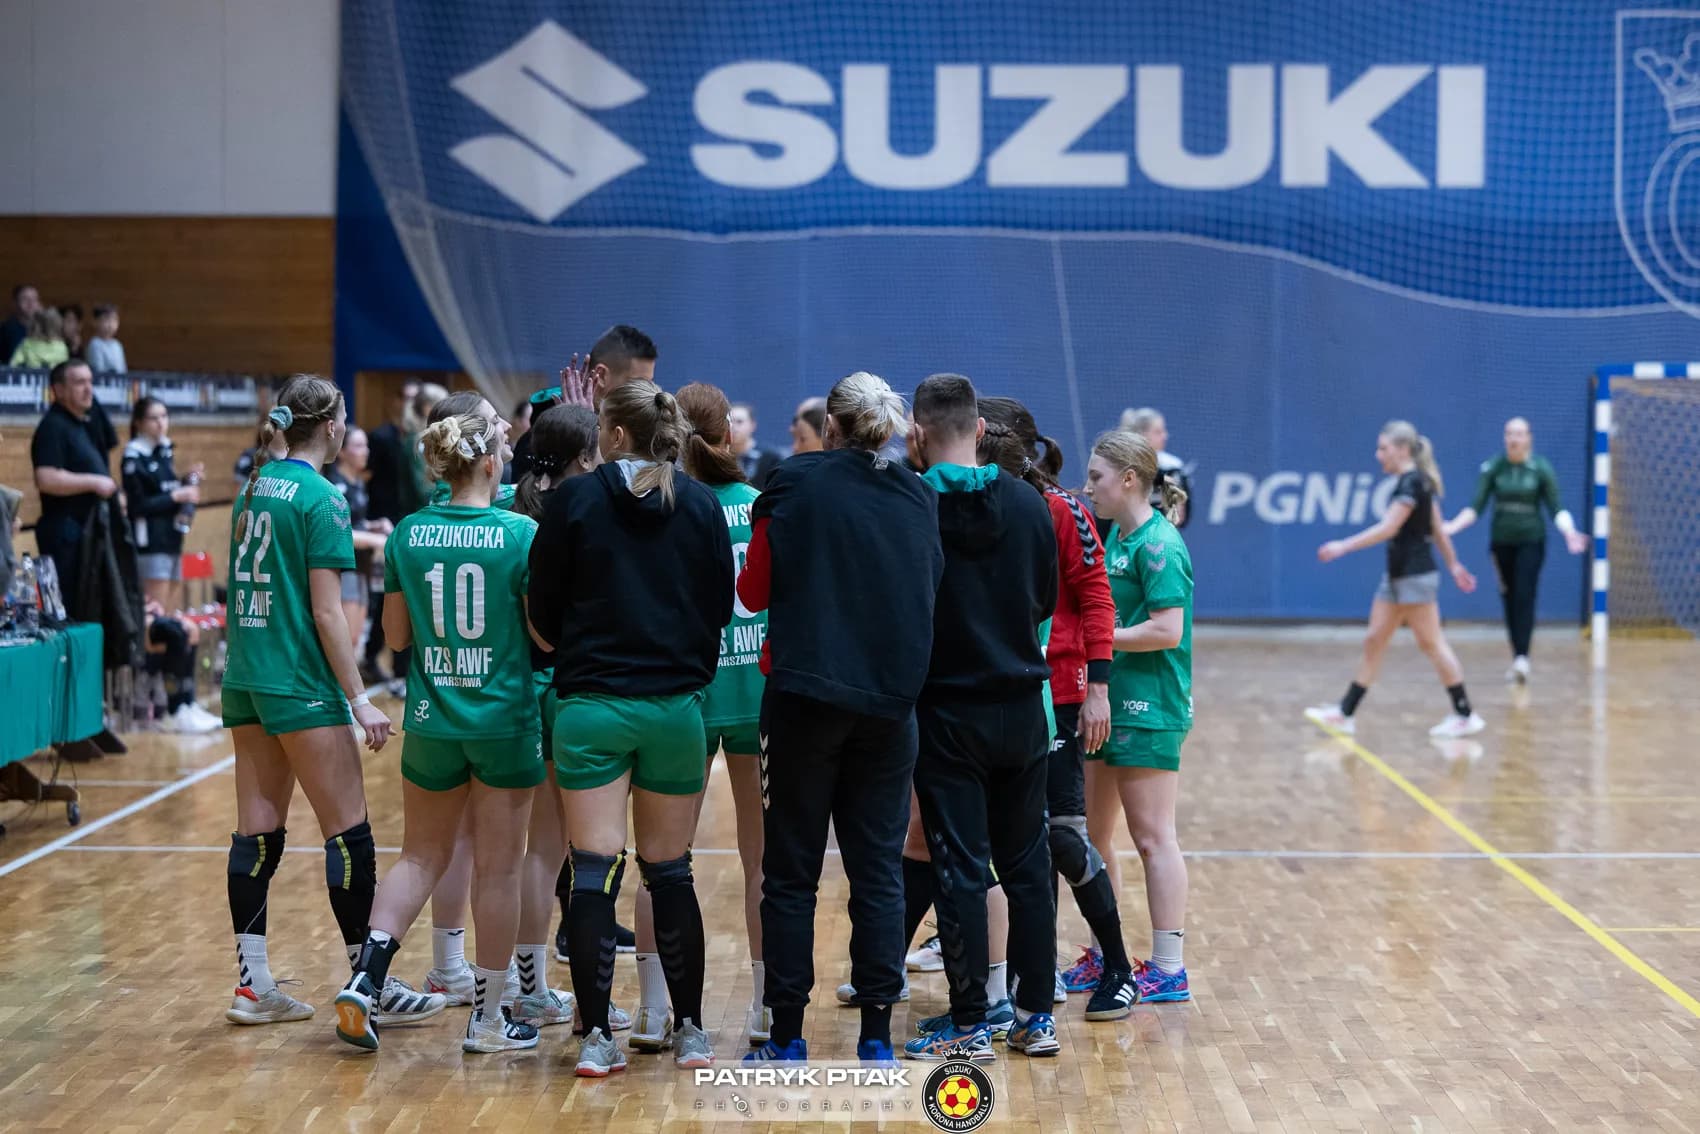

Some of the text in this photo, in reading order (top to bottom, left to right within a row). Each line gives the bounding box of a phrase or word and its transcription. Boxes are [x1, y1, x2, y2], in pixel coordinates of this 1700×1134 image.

[690, 61, 1486, 190] SUZUKI
[241, 477, 299, 502] ERNICKA
[235, 510, 271, 583] 22
[408, 525, 505, 549] SZCZUKOCKA
[235, 589, 273, 616] S AWF
[424, 563, 485, 640] 10
[424, 646, 493, 675] AZS AWF
[717, 653, 759, 667] ARSZAWA
[1122, 699, 1150, 712] YOGI
